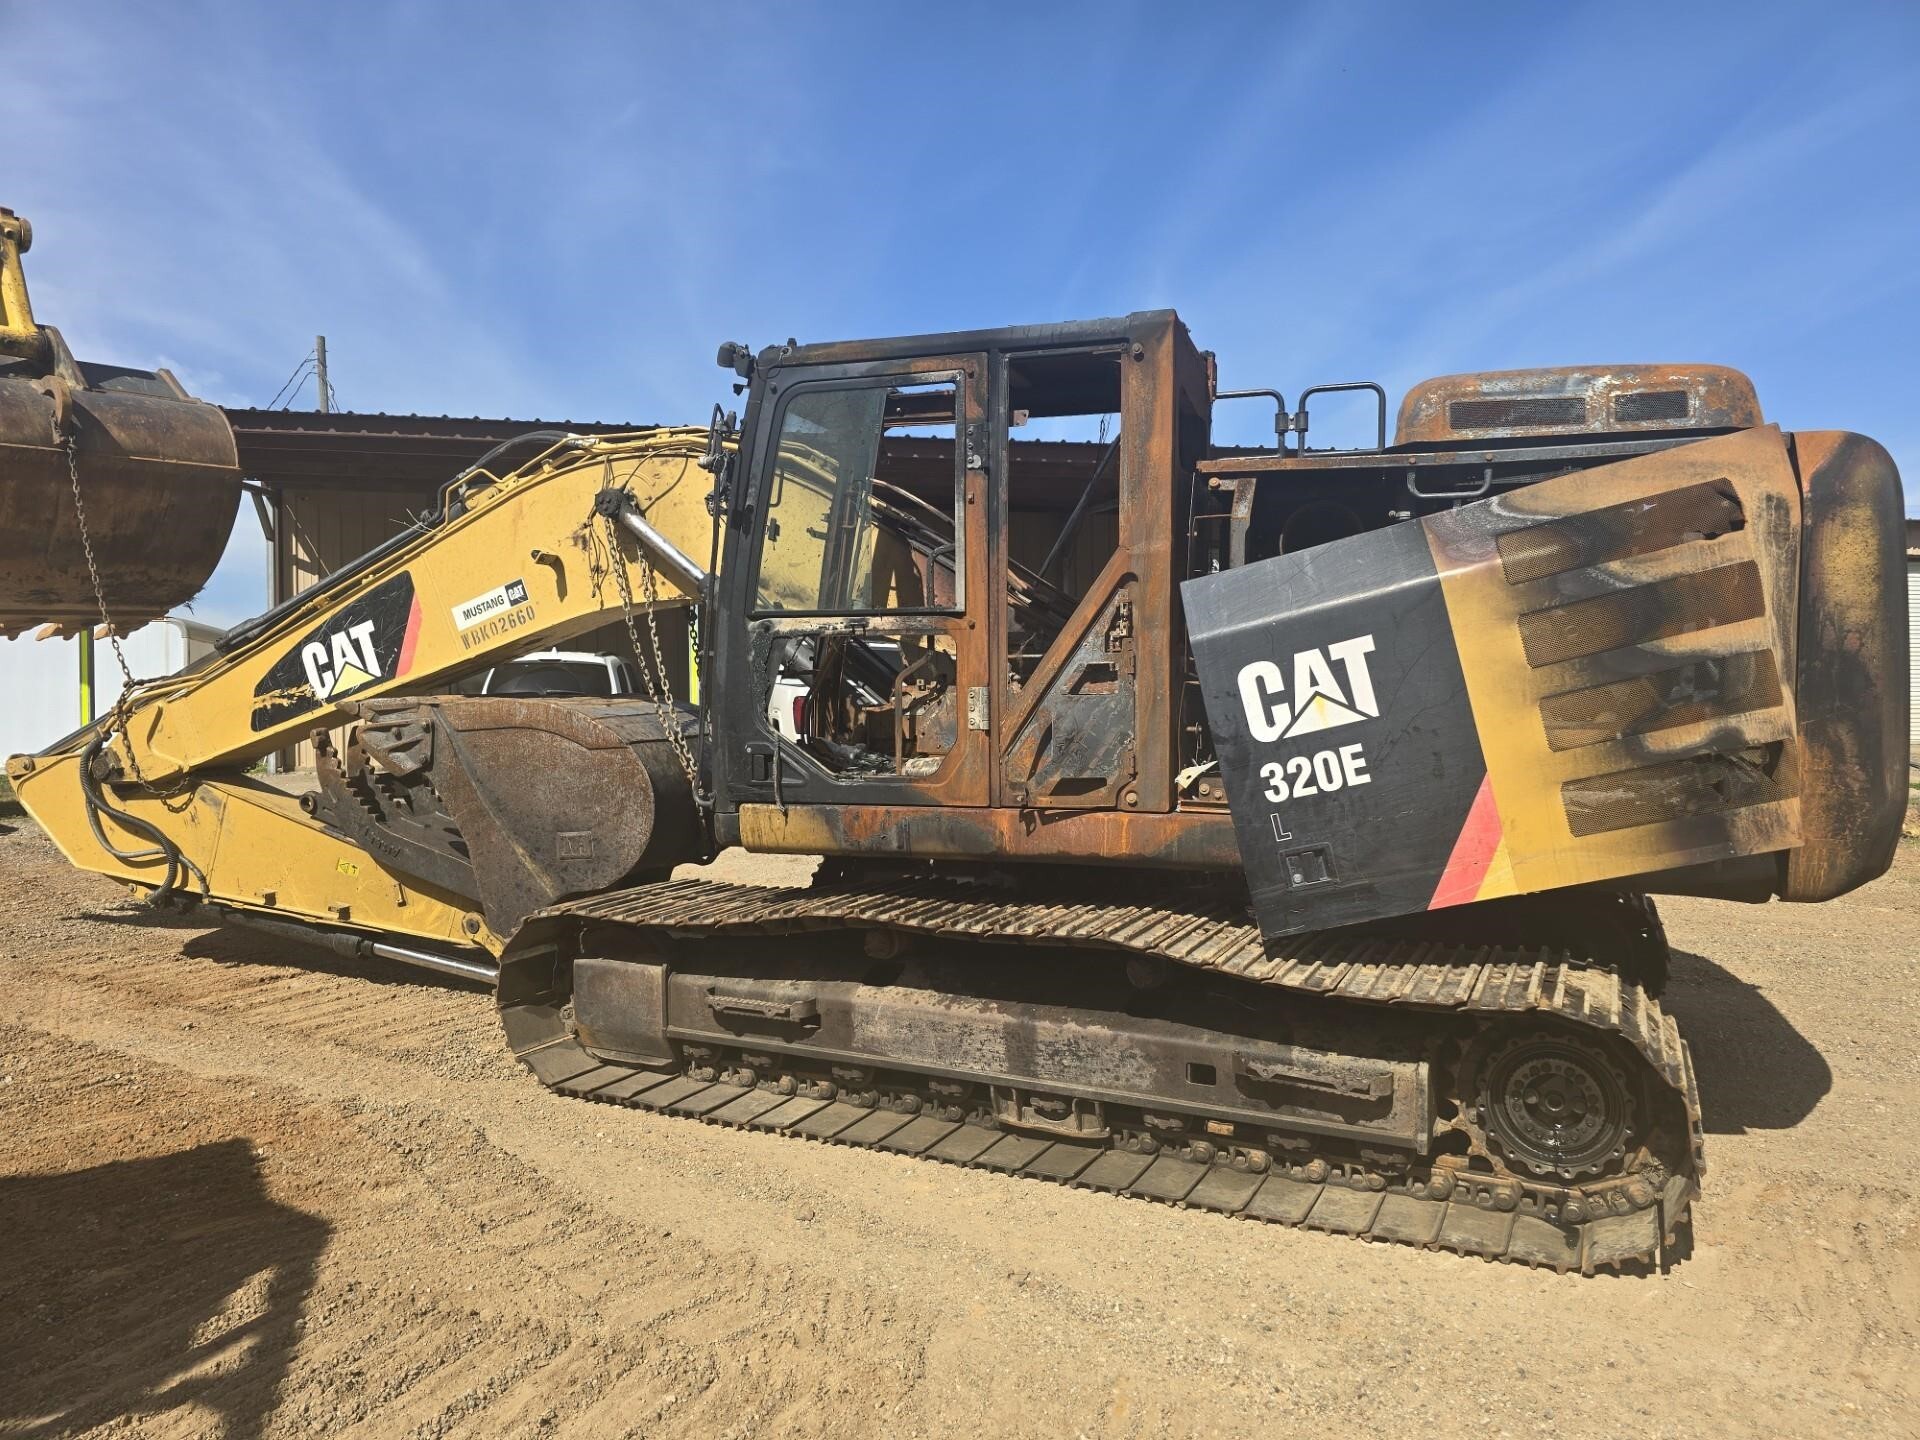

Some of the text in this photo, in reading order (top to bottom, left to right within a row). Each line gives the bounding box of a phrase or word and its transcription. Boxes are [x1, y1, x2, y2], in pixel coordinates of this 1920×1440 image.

[460, 605, 536, 650] WBK02660
[462, 584, 526, 621] MUSTANG CAT
[302, 619, 382, 702] CAT
[1237, 634, 1380, 743] CAT
[1259, 743, 1372, 803] 320E
[1270, 812, 1292, 842] L
